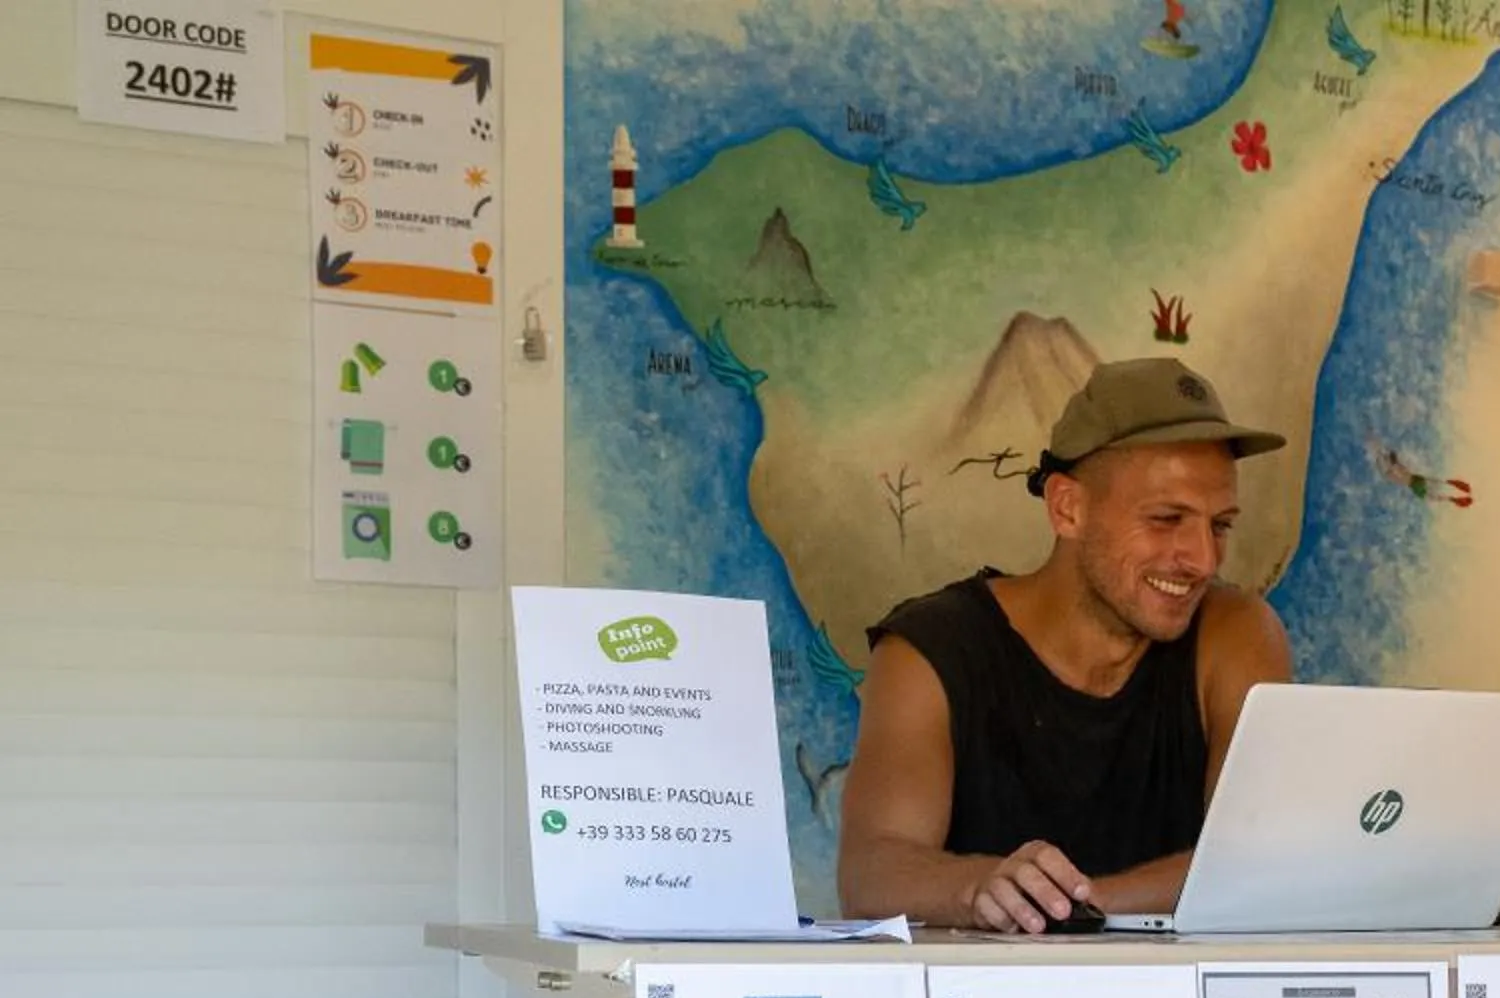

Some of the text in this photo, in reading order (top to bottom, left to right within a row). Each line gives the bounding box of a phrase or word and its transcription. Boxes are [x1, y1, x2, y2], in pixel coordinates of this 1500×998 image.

[106, 11, 246, 49] DOOR CODE
[125, 61, 237, 102] 2402#
[373, 156, 438, 173] CHECK-OUT
[375, 208, 472, 230] BREAKFAST TIME
[607, 623, 654, 643] Info
[615, 636, 667, 660] point
[543, 683, 712, 701] PIZZA, PASTA AND EVENTS
[545, 703, 593, 716] DIVING
[595, 704, 625, 716] AND
[547, 721, 664, 737] PHOTOSHOOTING
[549, 741, 613, 754] MASSAGE
[541, 784, 755, 807] RESPONSIBLE: PASQUALE
[1361, 789, 1403, 834] hp
[576, 825, 732, 843] +39 333 58 60 275
